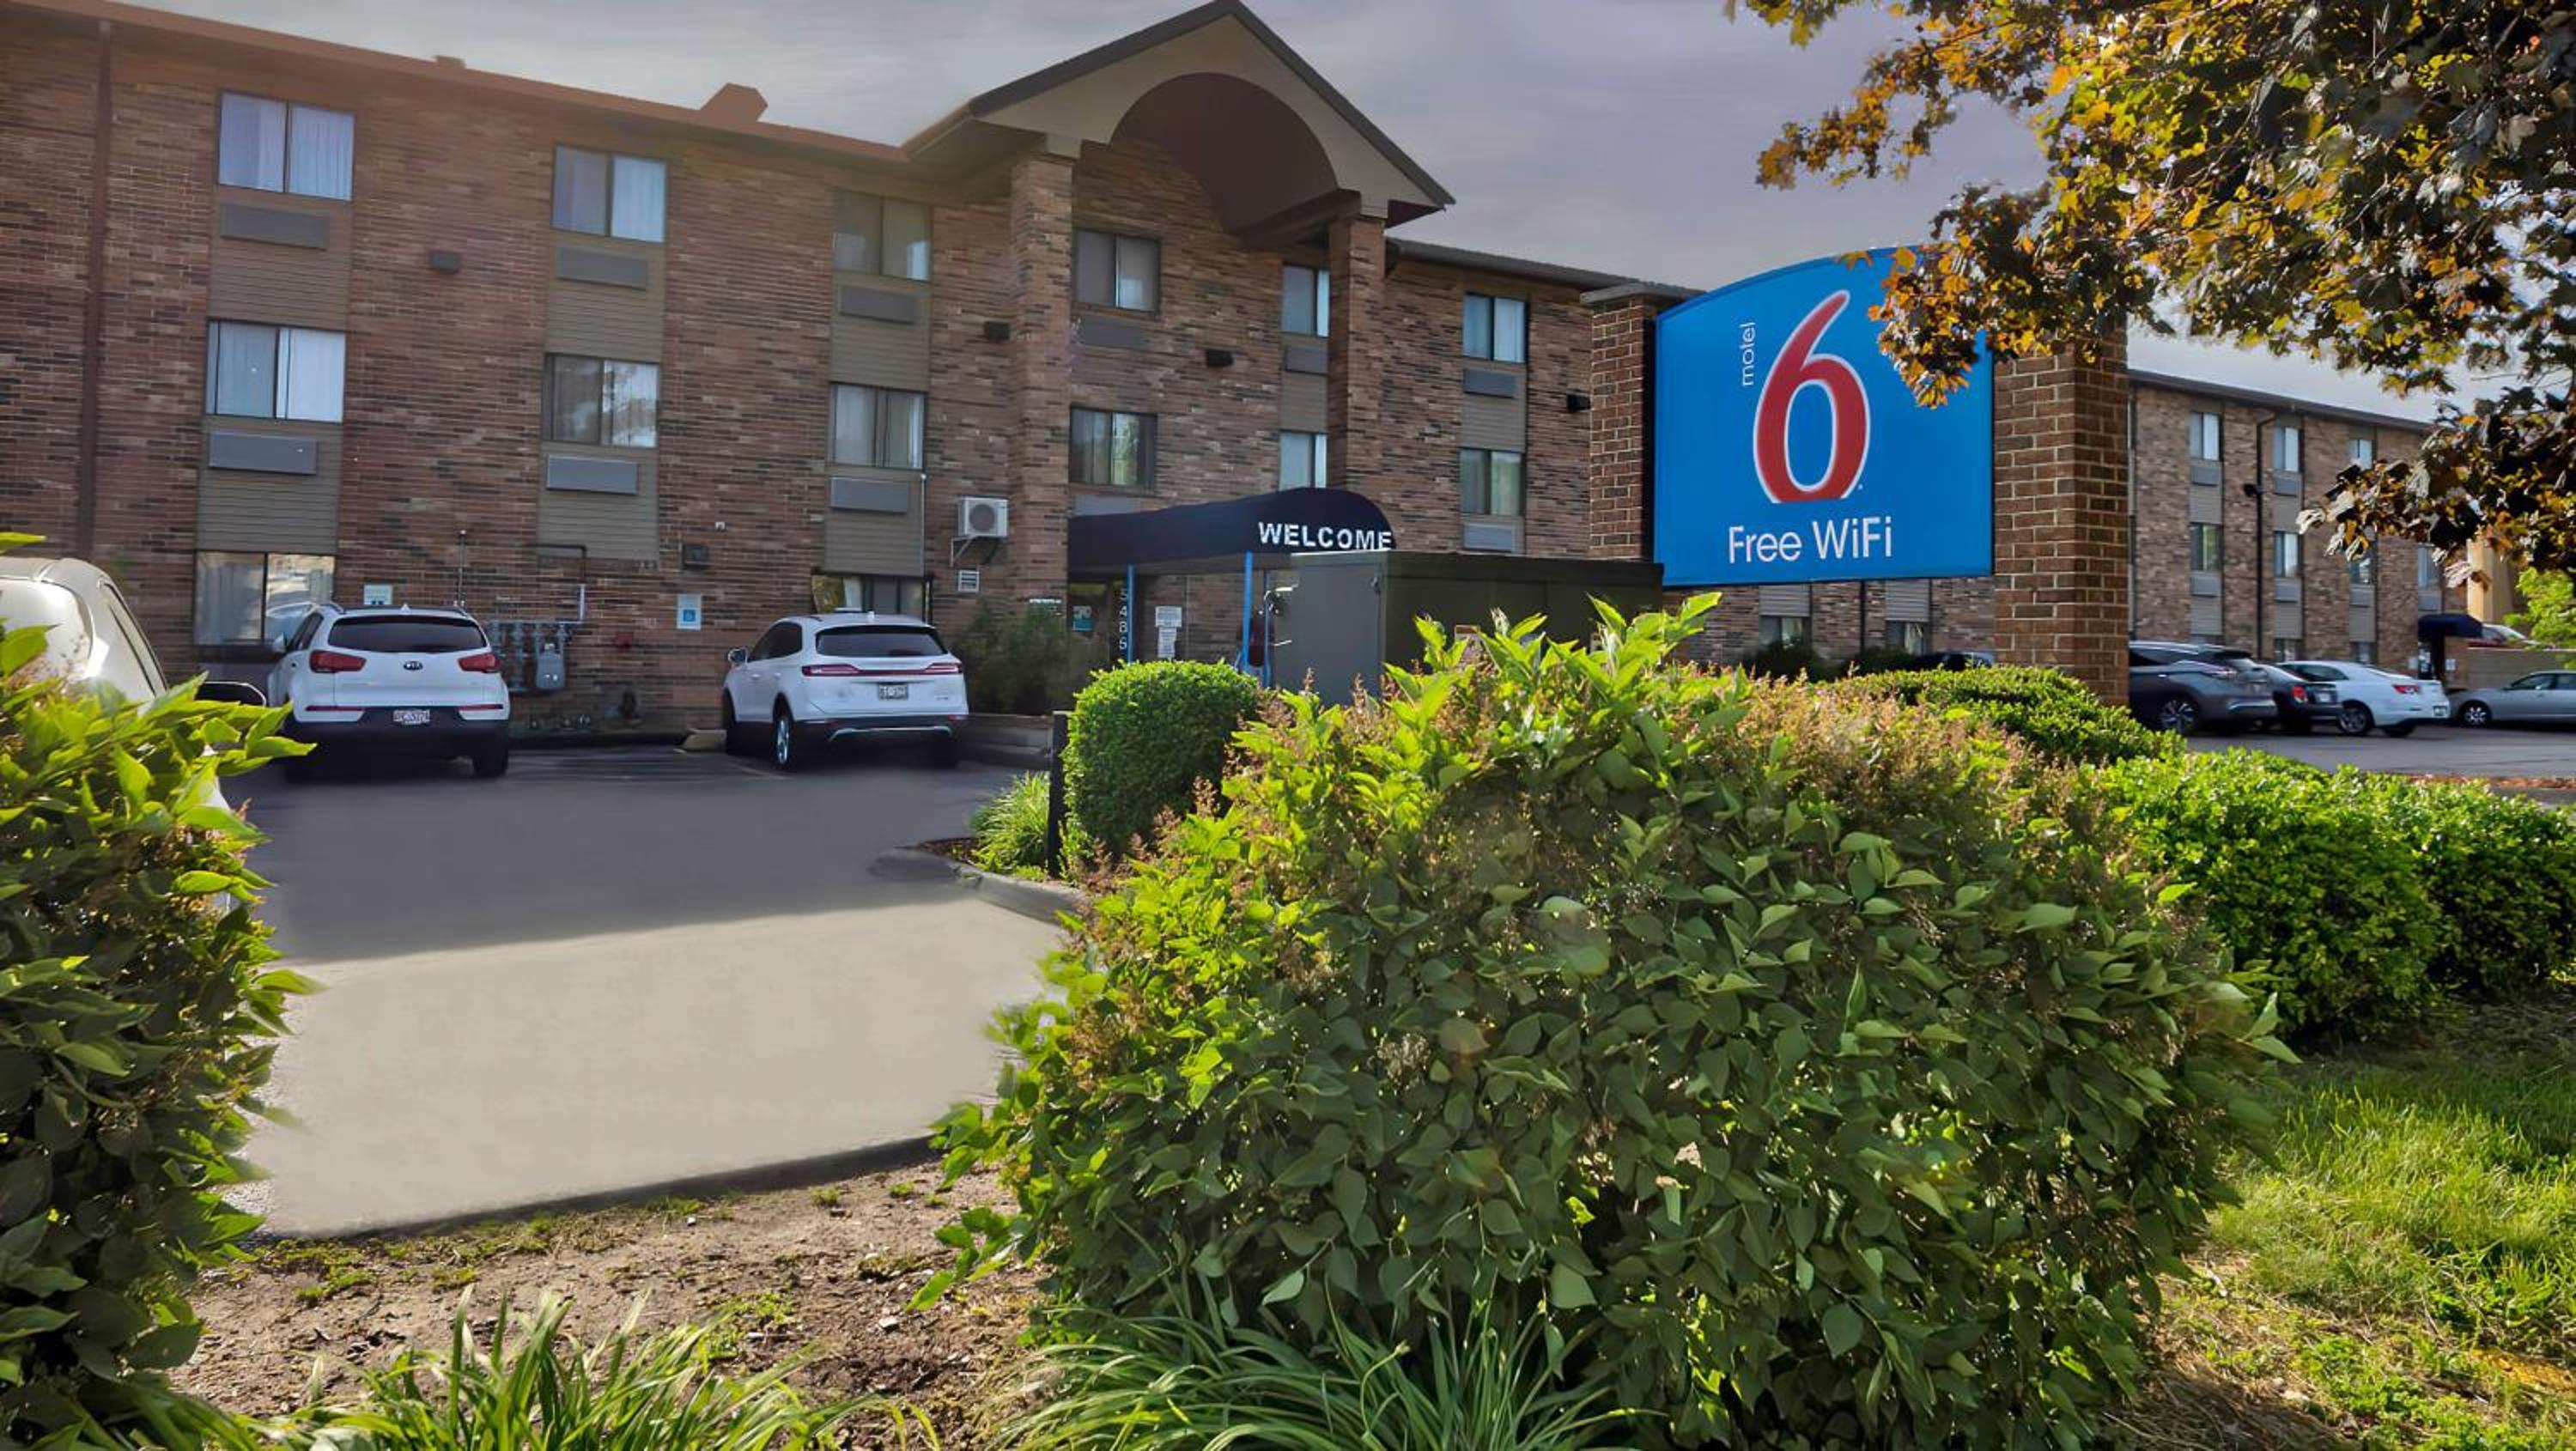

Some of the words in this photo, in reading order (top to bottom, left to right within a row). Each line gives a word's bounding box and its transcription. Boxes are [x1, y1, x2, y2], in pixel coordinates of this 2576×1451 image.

[1739, 321, 1756, 386] motel
[1753, 289, 1871, 504] 6
[1258, 521, 1392, 550] WELCOME
[1728, 525, 1802, 563] Free
[1812, 516, 1892, 559] WiFi
